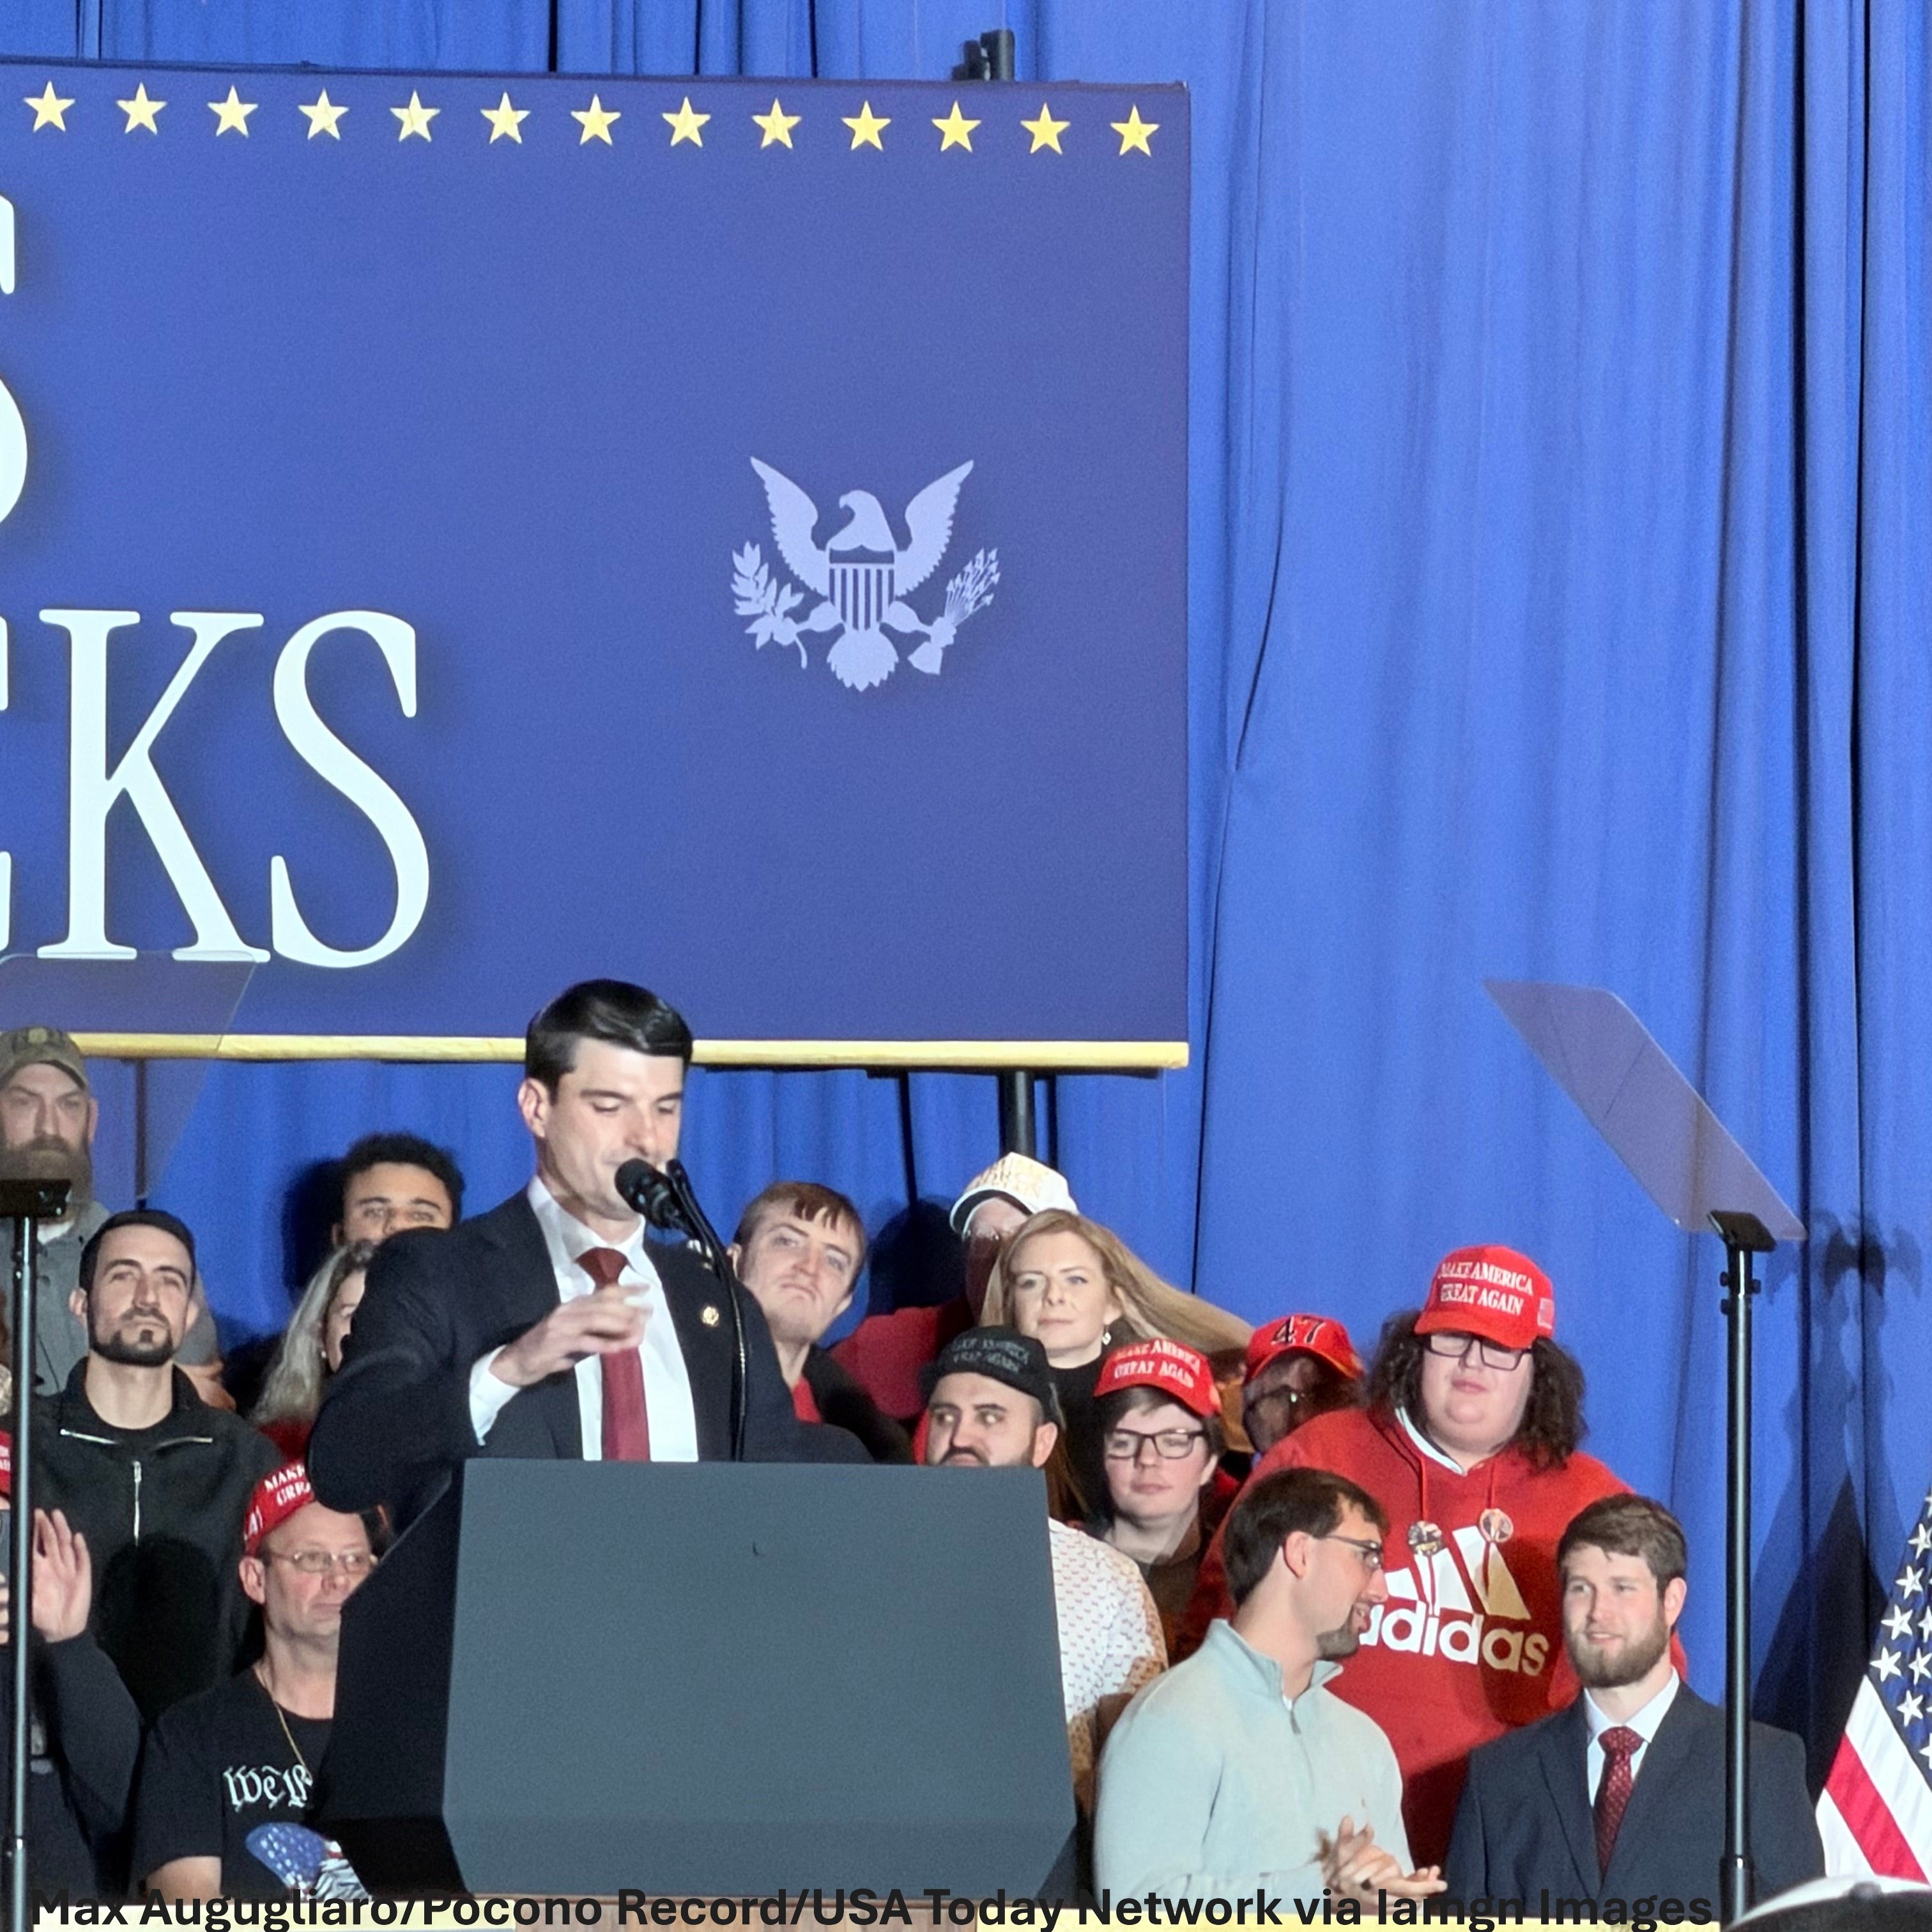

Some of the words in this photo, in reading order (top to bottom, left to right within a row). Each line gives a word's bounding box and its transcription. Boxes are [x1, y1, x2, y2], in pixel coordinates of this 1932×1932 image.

[0, 610, 429, 968] KS
[1471, 1262, 1533, 1296] AMERICA
[1477, 1287, 1524, 1316] AGAIN
[1270, 1315, 1327, 1345] 47
